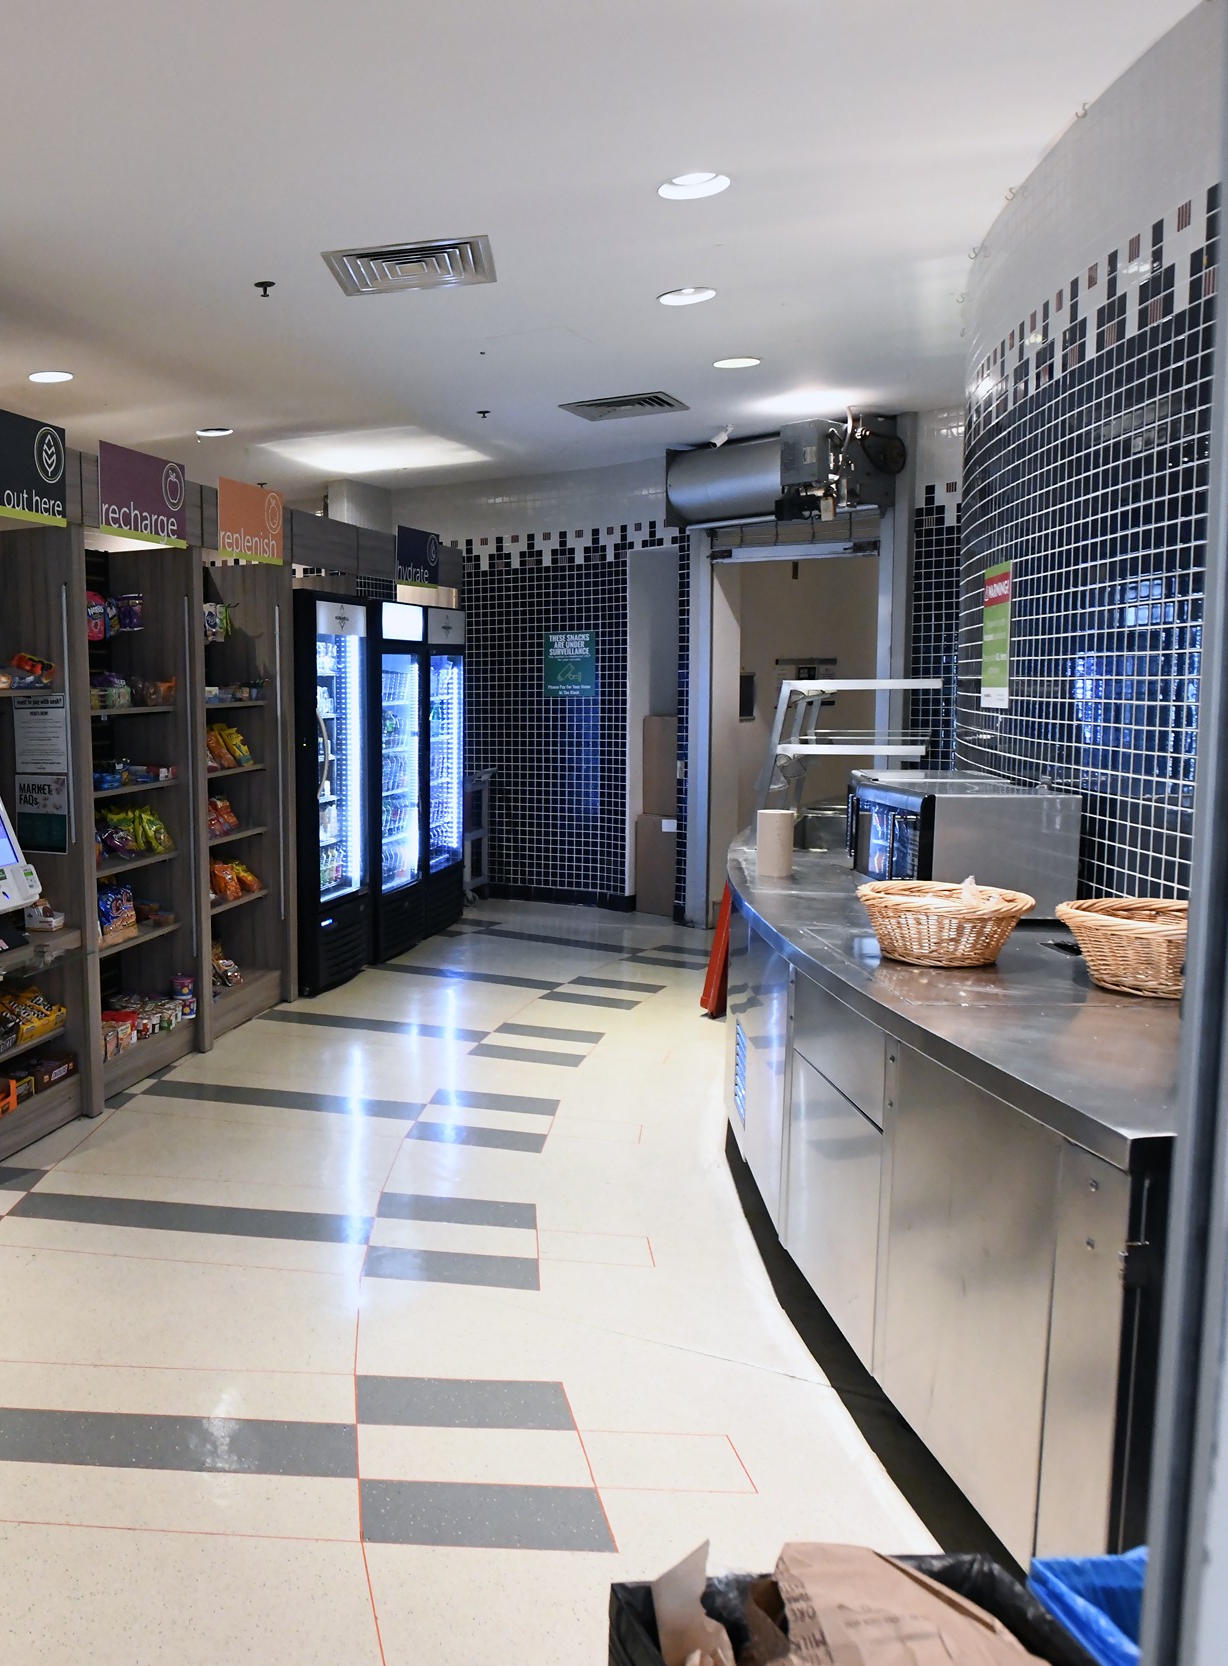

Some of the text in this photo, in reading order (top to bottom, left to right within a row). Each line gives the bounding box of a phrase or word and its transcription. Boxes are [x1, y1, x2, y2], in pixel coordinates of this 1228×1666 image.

[4, 490, 28, 512] out
[32, 490, 62, 518] here
[102, 502, 178, 545] recharge
[220, 528, 277, 560] replenish
[396, 560, 428, 584] hydrate
[549, 647, 589, 655] SURVEILLANCE
[19, 784, 51, 794] MARKET
[20, 794, 38, 806] FAQs
